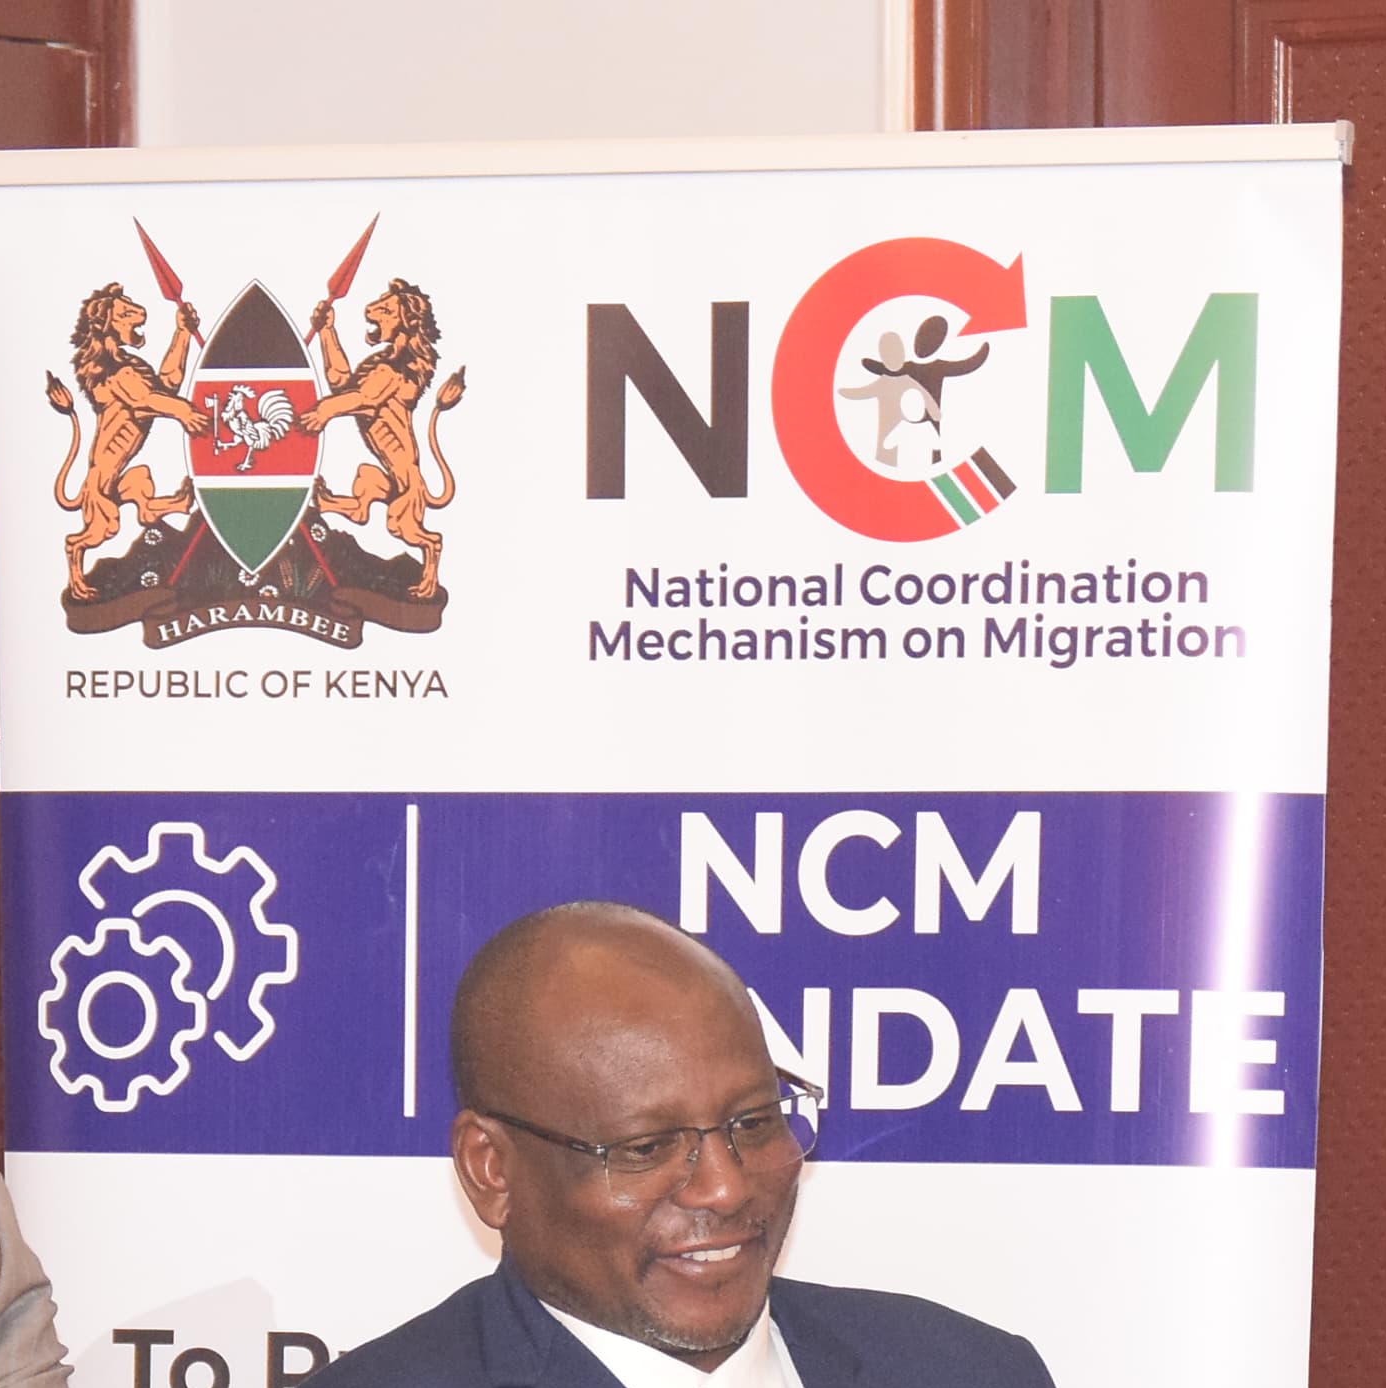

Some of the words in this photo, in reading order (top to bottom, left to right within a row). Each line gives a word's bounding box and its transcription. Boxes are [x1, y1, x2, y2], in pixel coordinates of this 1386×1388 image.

[586, 236, 1260, 543] NCM
[624, 561, 844, 608] National
[859, 556, 1210, 608] Coordination
[158, 603, 351, 643] HARAMBEE
[588, 614, 888, 663] Mechanism
[902, 626, 966, 660] on
[983, 611, 1247, 670] Migration
[65, 669, 250, 699] REPUBLIC
[260, 669, 313, 699] OF
[325, 669, 450, 699] KENYA
[679, 810, 1041, 936] NCM
[747, 987, 1286, 1115] NDATE
